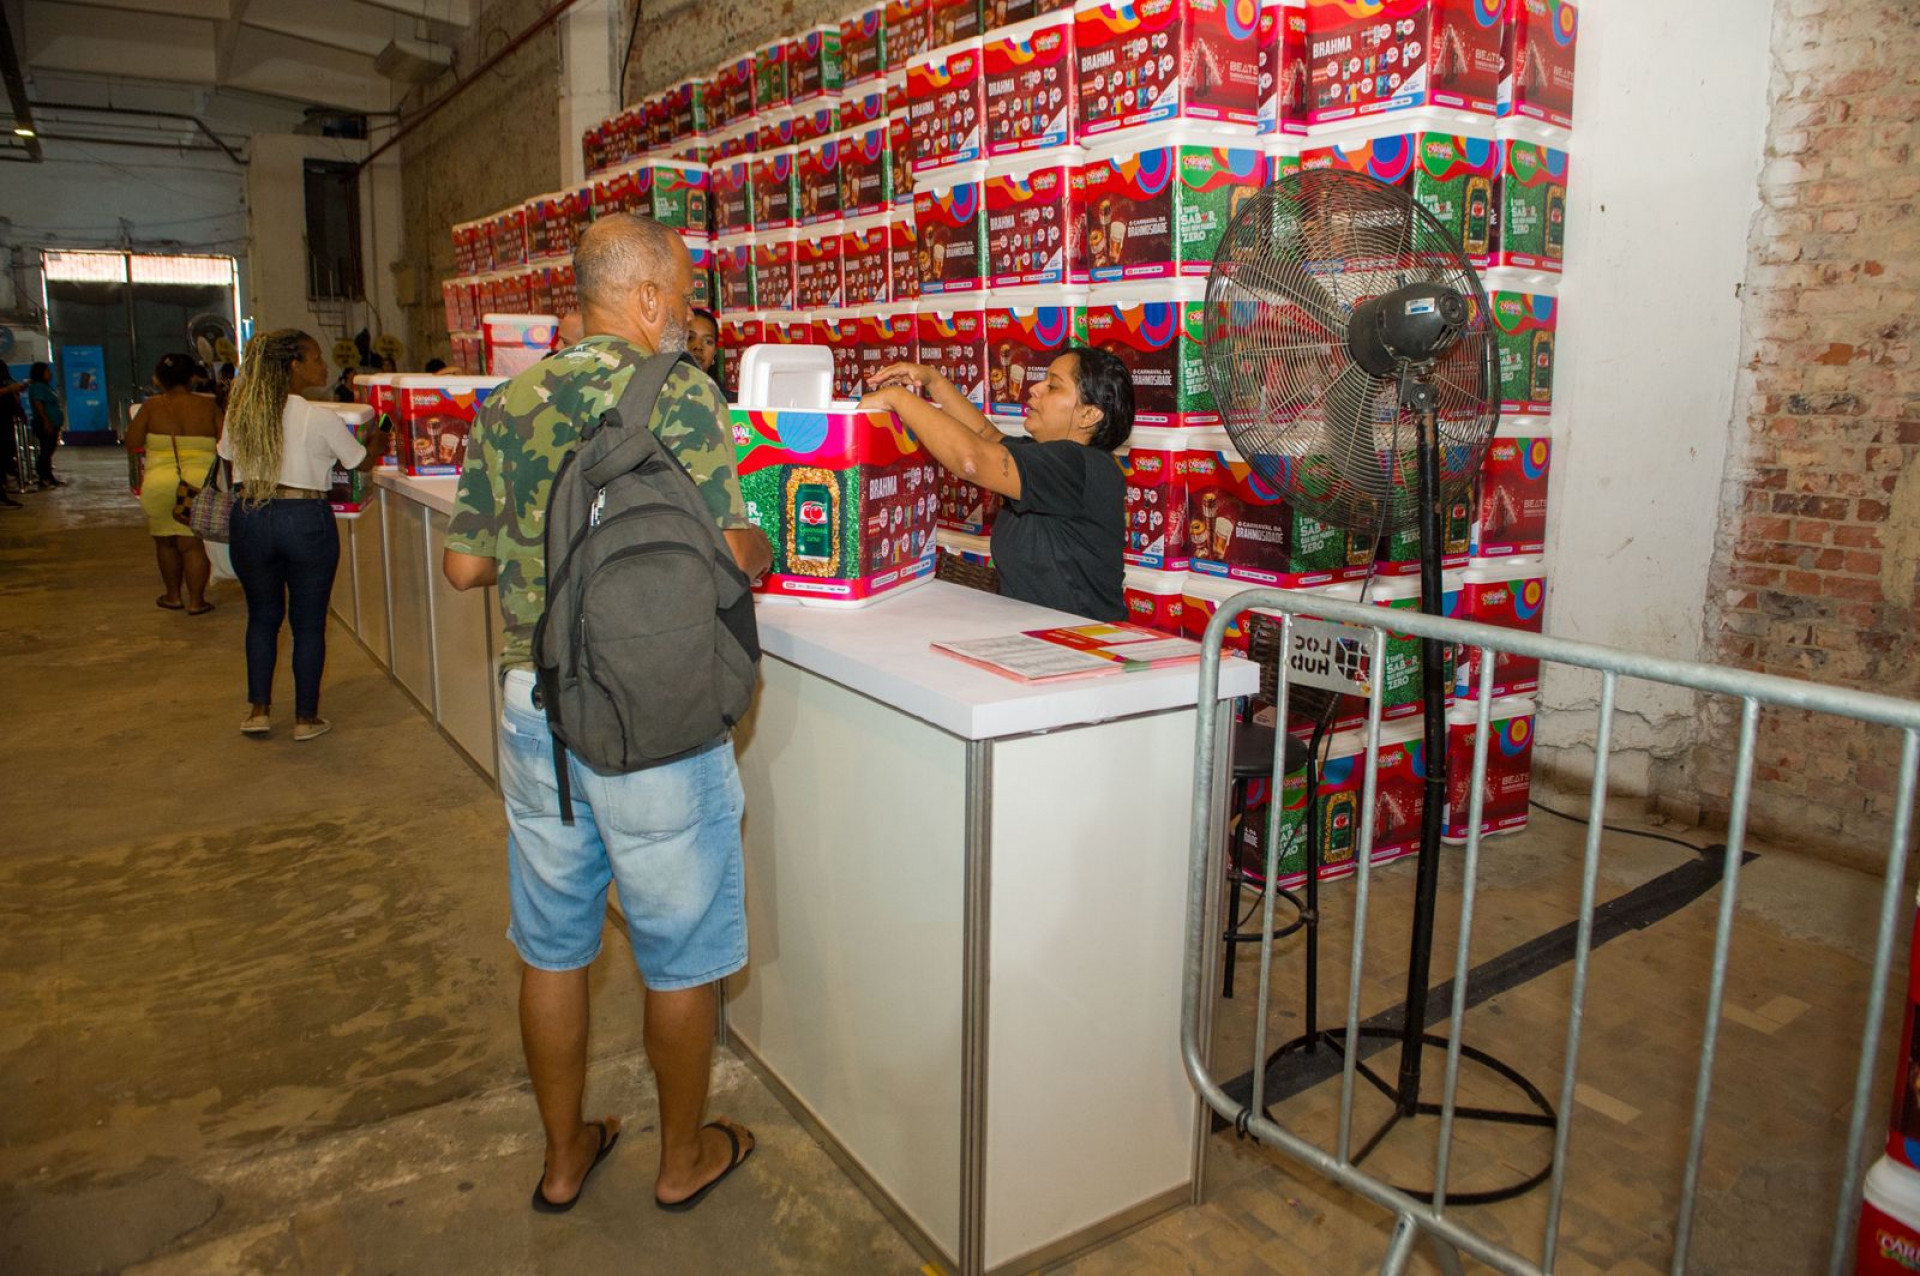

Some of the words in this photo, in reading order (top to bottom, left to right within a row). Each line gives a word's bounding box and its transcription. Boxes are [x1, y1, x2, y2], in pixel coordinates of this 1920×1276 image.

[1312, 35, 1352, 59] BRAHMA
[1081, 50, 1116, 73] BRAHMA
[1229, 61, 1259, 75] BEATS
[988, 78, 1015, 97] BRAHMA
[990, 214, 1016, 231] BRAHMA
[1182, 231, 1206, 244] ZERO
[1187, 383, 1209, 396] ZERO
[869, 475, 897, 500] BRAHMA
[1243, 522, 1273, 531] CARNAVAL
[1235, 527, 1284, 545] BRAHMOSIDADE
[1302, 541, 1325, 555] ZERO
[1387, 676, 1409, 691] ZERO
[1502, 772, 1530, 785] BEATS
